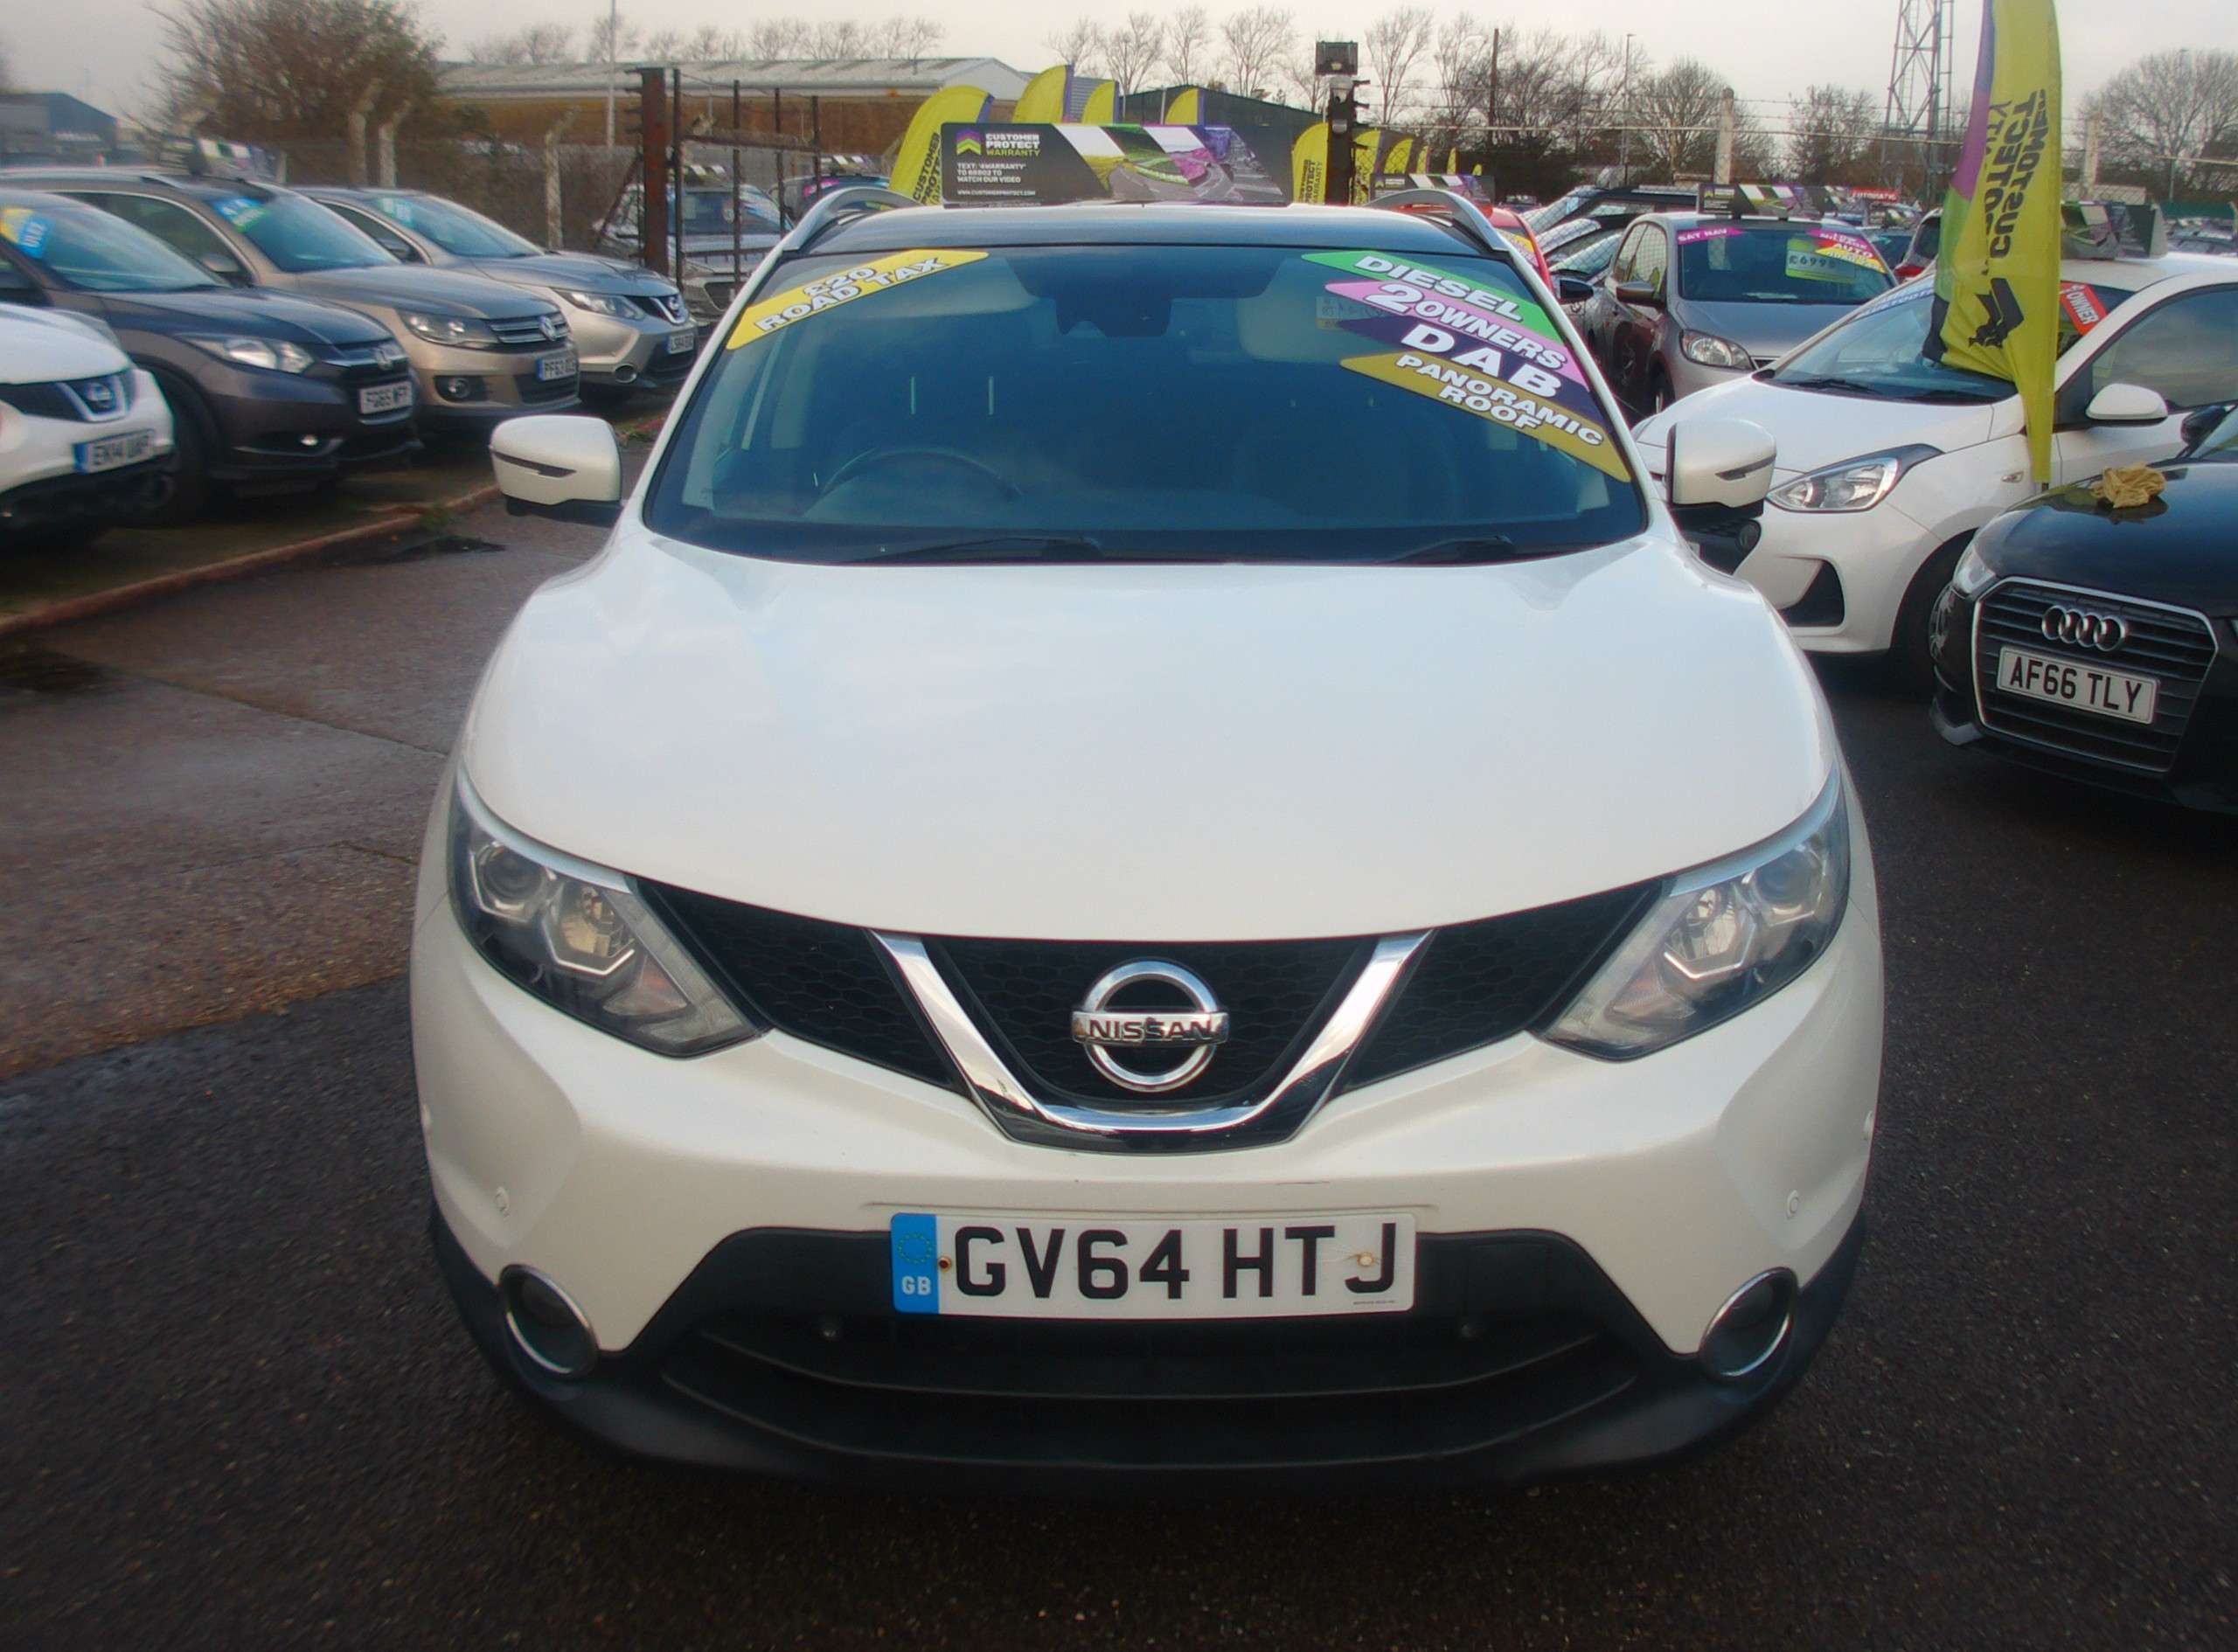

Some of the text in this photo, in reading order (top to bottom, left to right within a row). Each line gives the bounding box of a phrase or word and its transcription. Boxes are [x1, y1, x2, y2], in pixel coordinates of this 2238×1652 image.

[913, 132, 940, 201] CUSTOMER
[754, 257, 950, 332] ROAD TAX
[1354, 255, 1524, 323] DIESEL
[2067, 292, 2099, 325] OWNER
[1400, 323, 1563, 399] DAB
[1395, 353, 1604, 446] PANORAMIC
[1439, 383, 1543, 431] ROOF
[2010, 656, 2142, 714] AF66 TLY
[1089, 1017, 1213, 1039] NISSAN
[901, 1274, 931, 1296] GB
[955, 1222, 1397, 1301] GV64 HTJ
